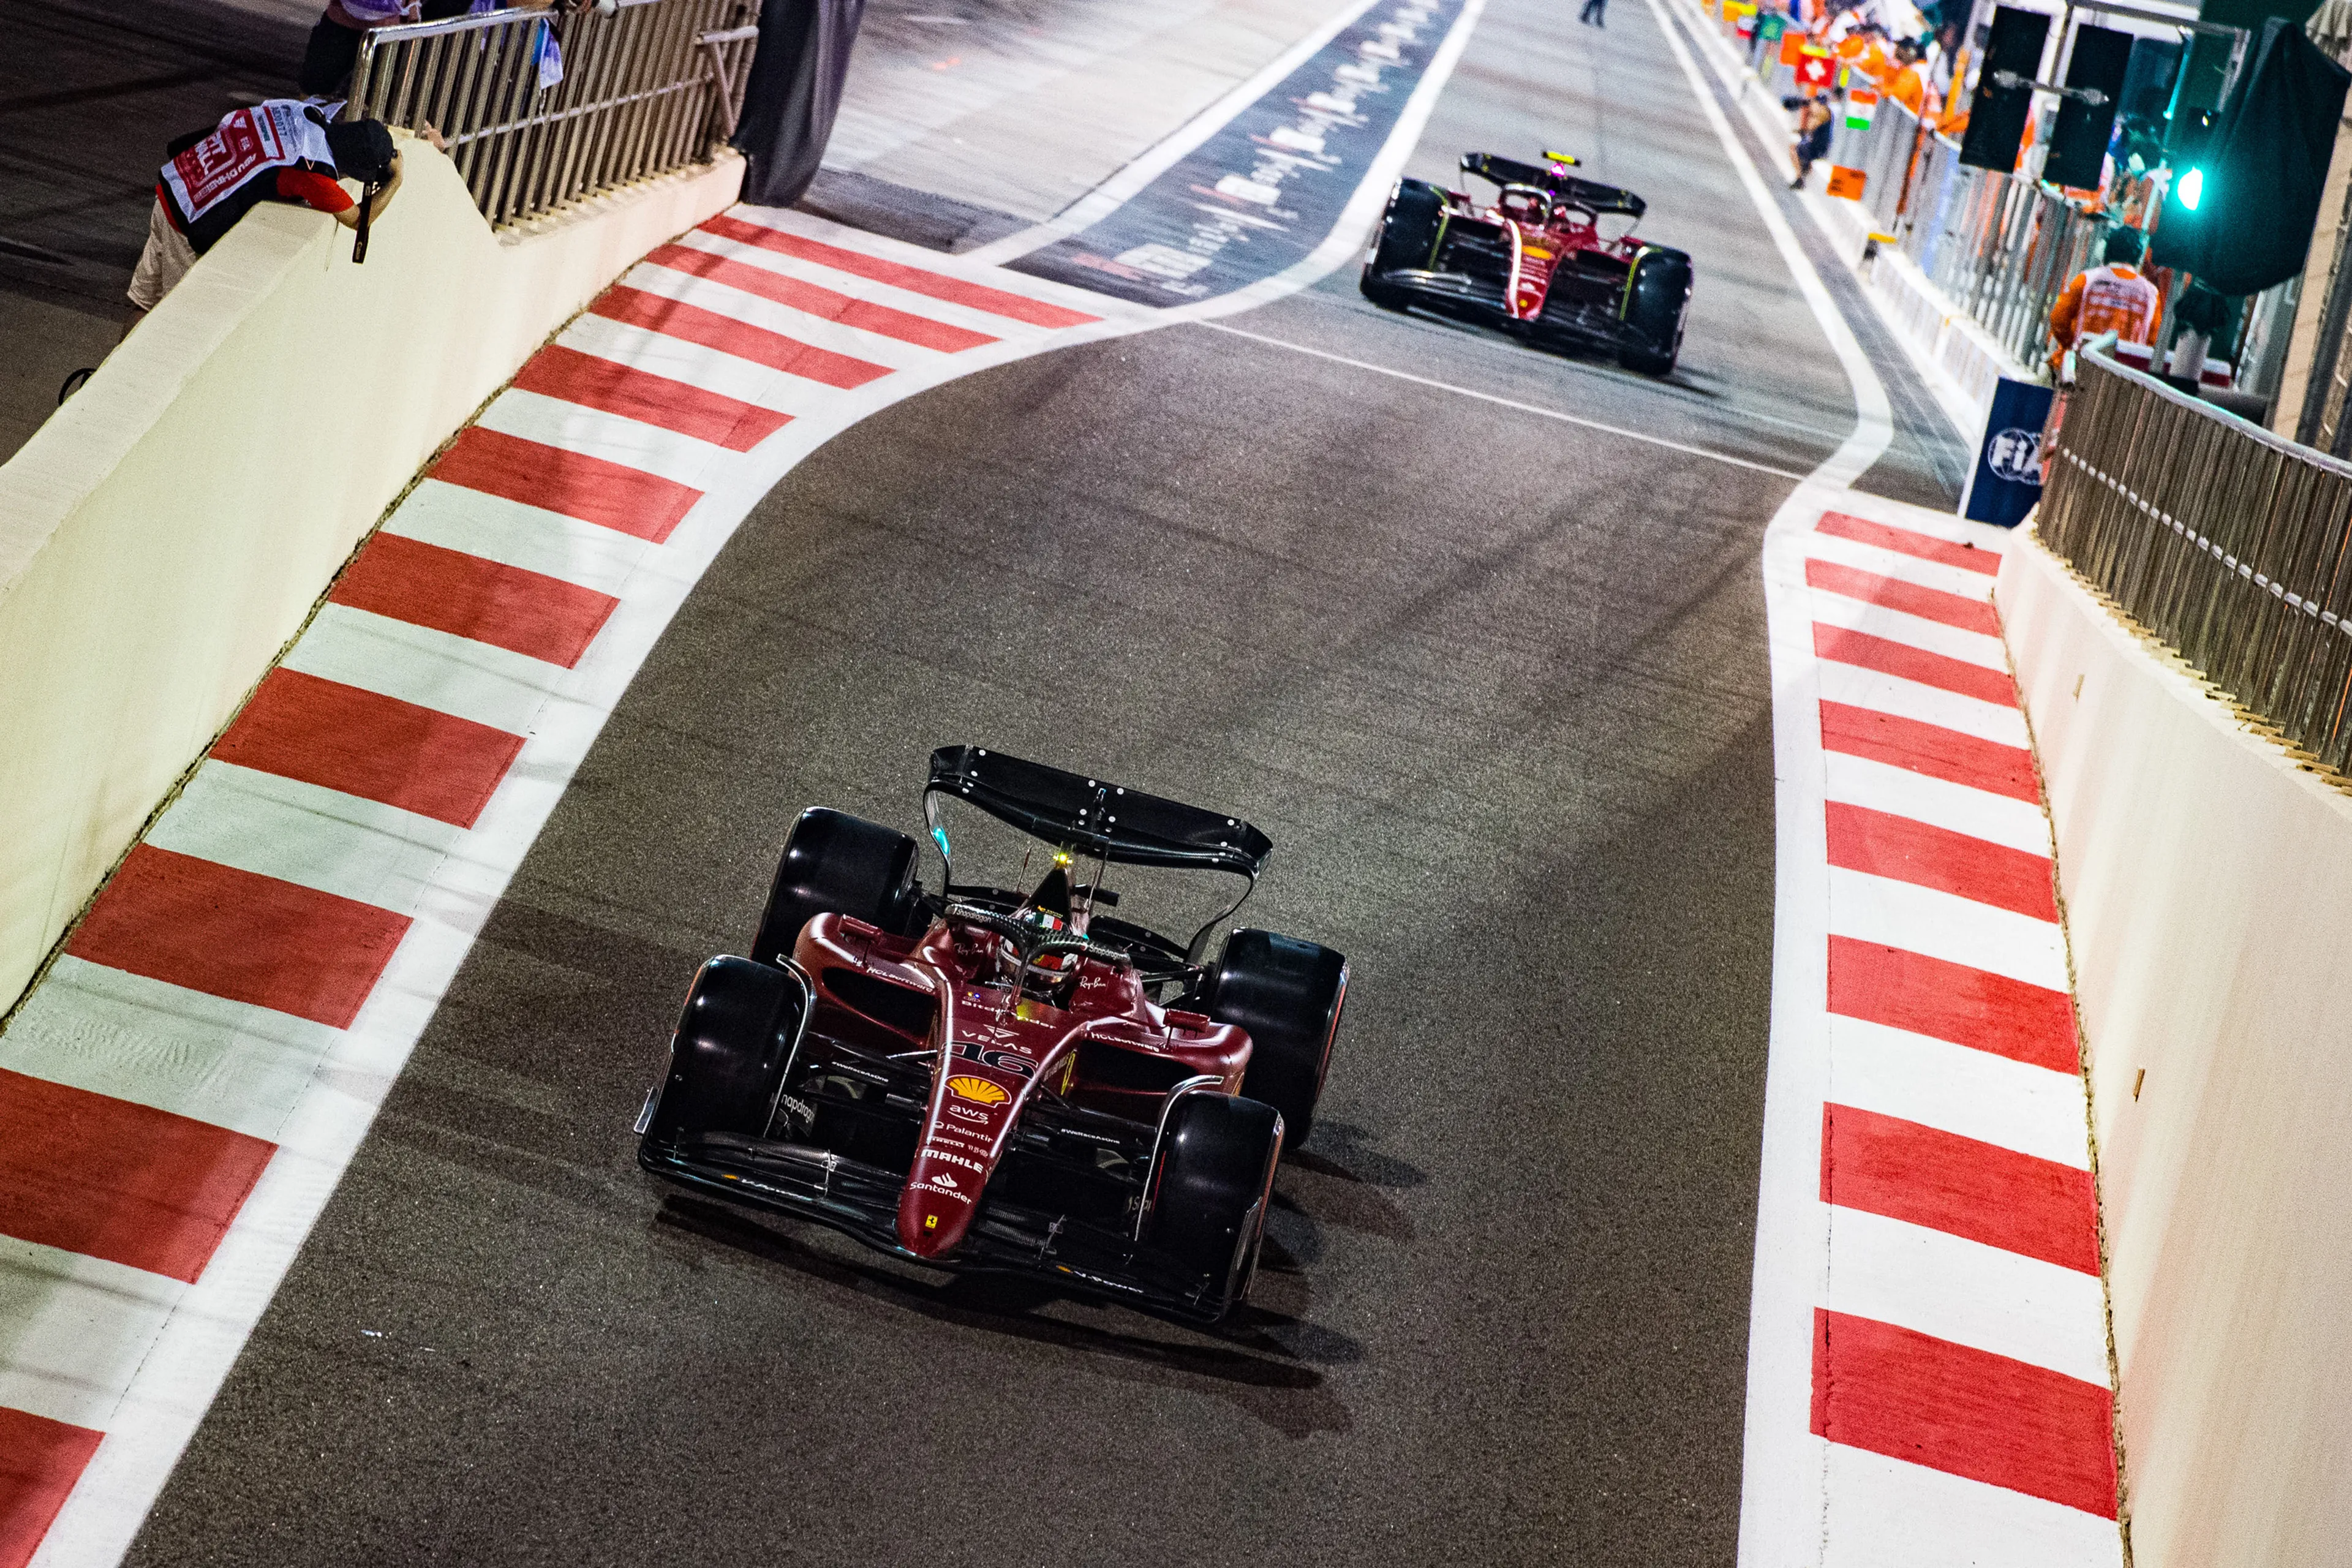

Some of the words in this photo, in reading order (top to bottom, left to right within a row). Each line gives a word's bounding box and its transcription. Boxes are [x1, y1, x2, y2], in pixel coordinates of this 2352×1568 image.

[957, 908, 992, 924] Snapdragon
[962, 1030, 1032, 1055] VELAS
[938, 1040, 1039, 1081] 16
[949, 1104, 989, 1121] aws
[946, 1124, 993, 1143] Palantir
[921, 1148, 984, 1174] MAHLE
[909, 1182, 973, 1205] Santander
